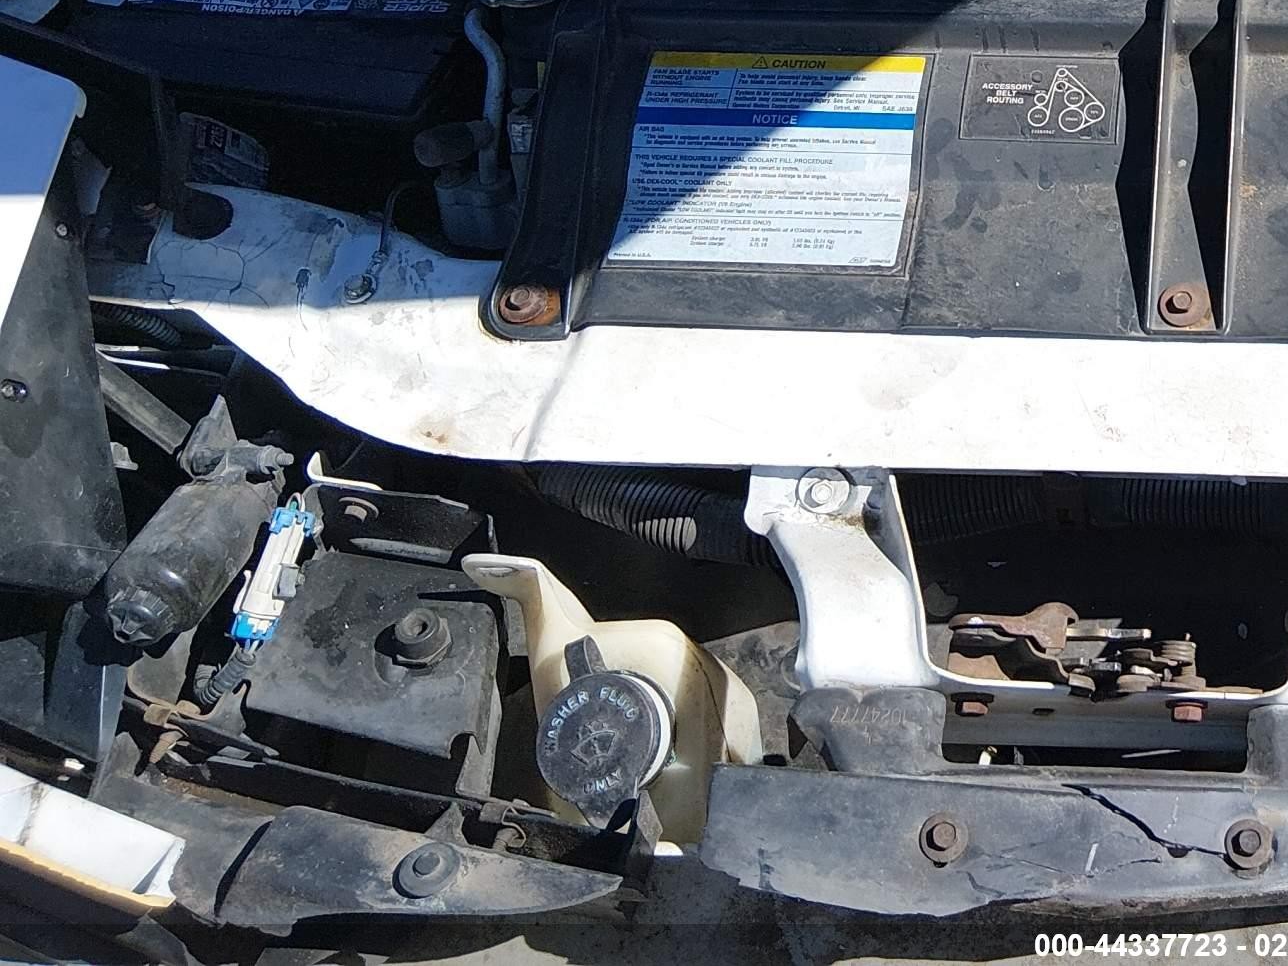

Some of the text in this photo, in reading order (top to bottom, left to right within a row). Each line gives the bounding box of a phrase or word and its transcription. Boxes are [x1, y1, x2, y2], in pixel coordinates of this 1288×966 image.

[772, 59, 826, 69] CAUTION
[982, 82, 1034, 91] ACCESSORY
[995, 89, 1017, 97] BELT
[986, 96, 1025, 104] ROUTING
[752, 113, 798, 125] NOTICE
[544, 690, 590, 755] WASHER
[583, 769, 622, 794] ONLY
